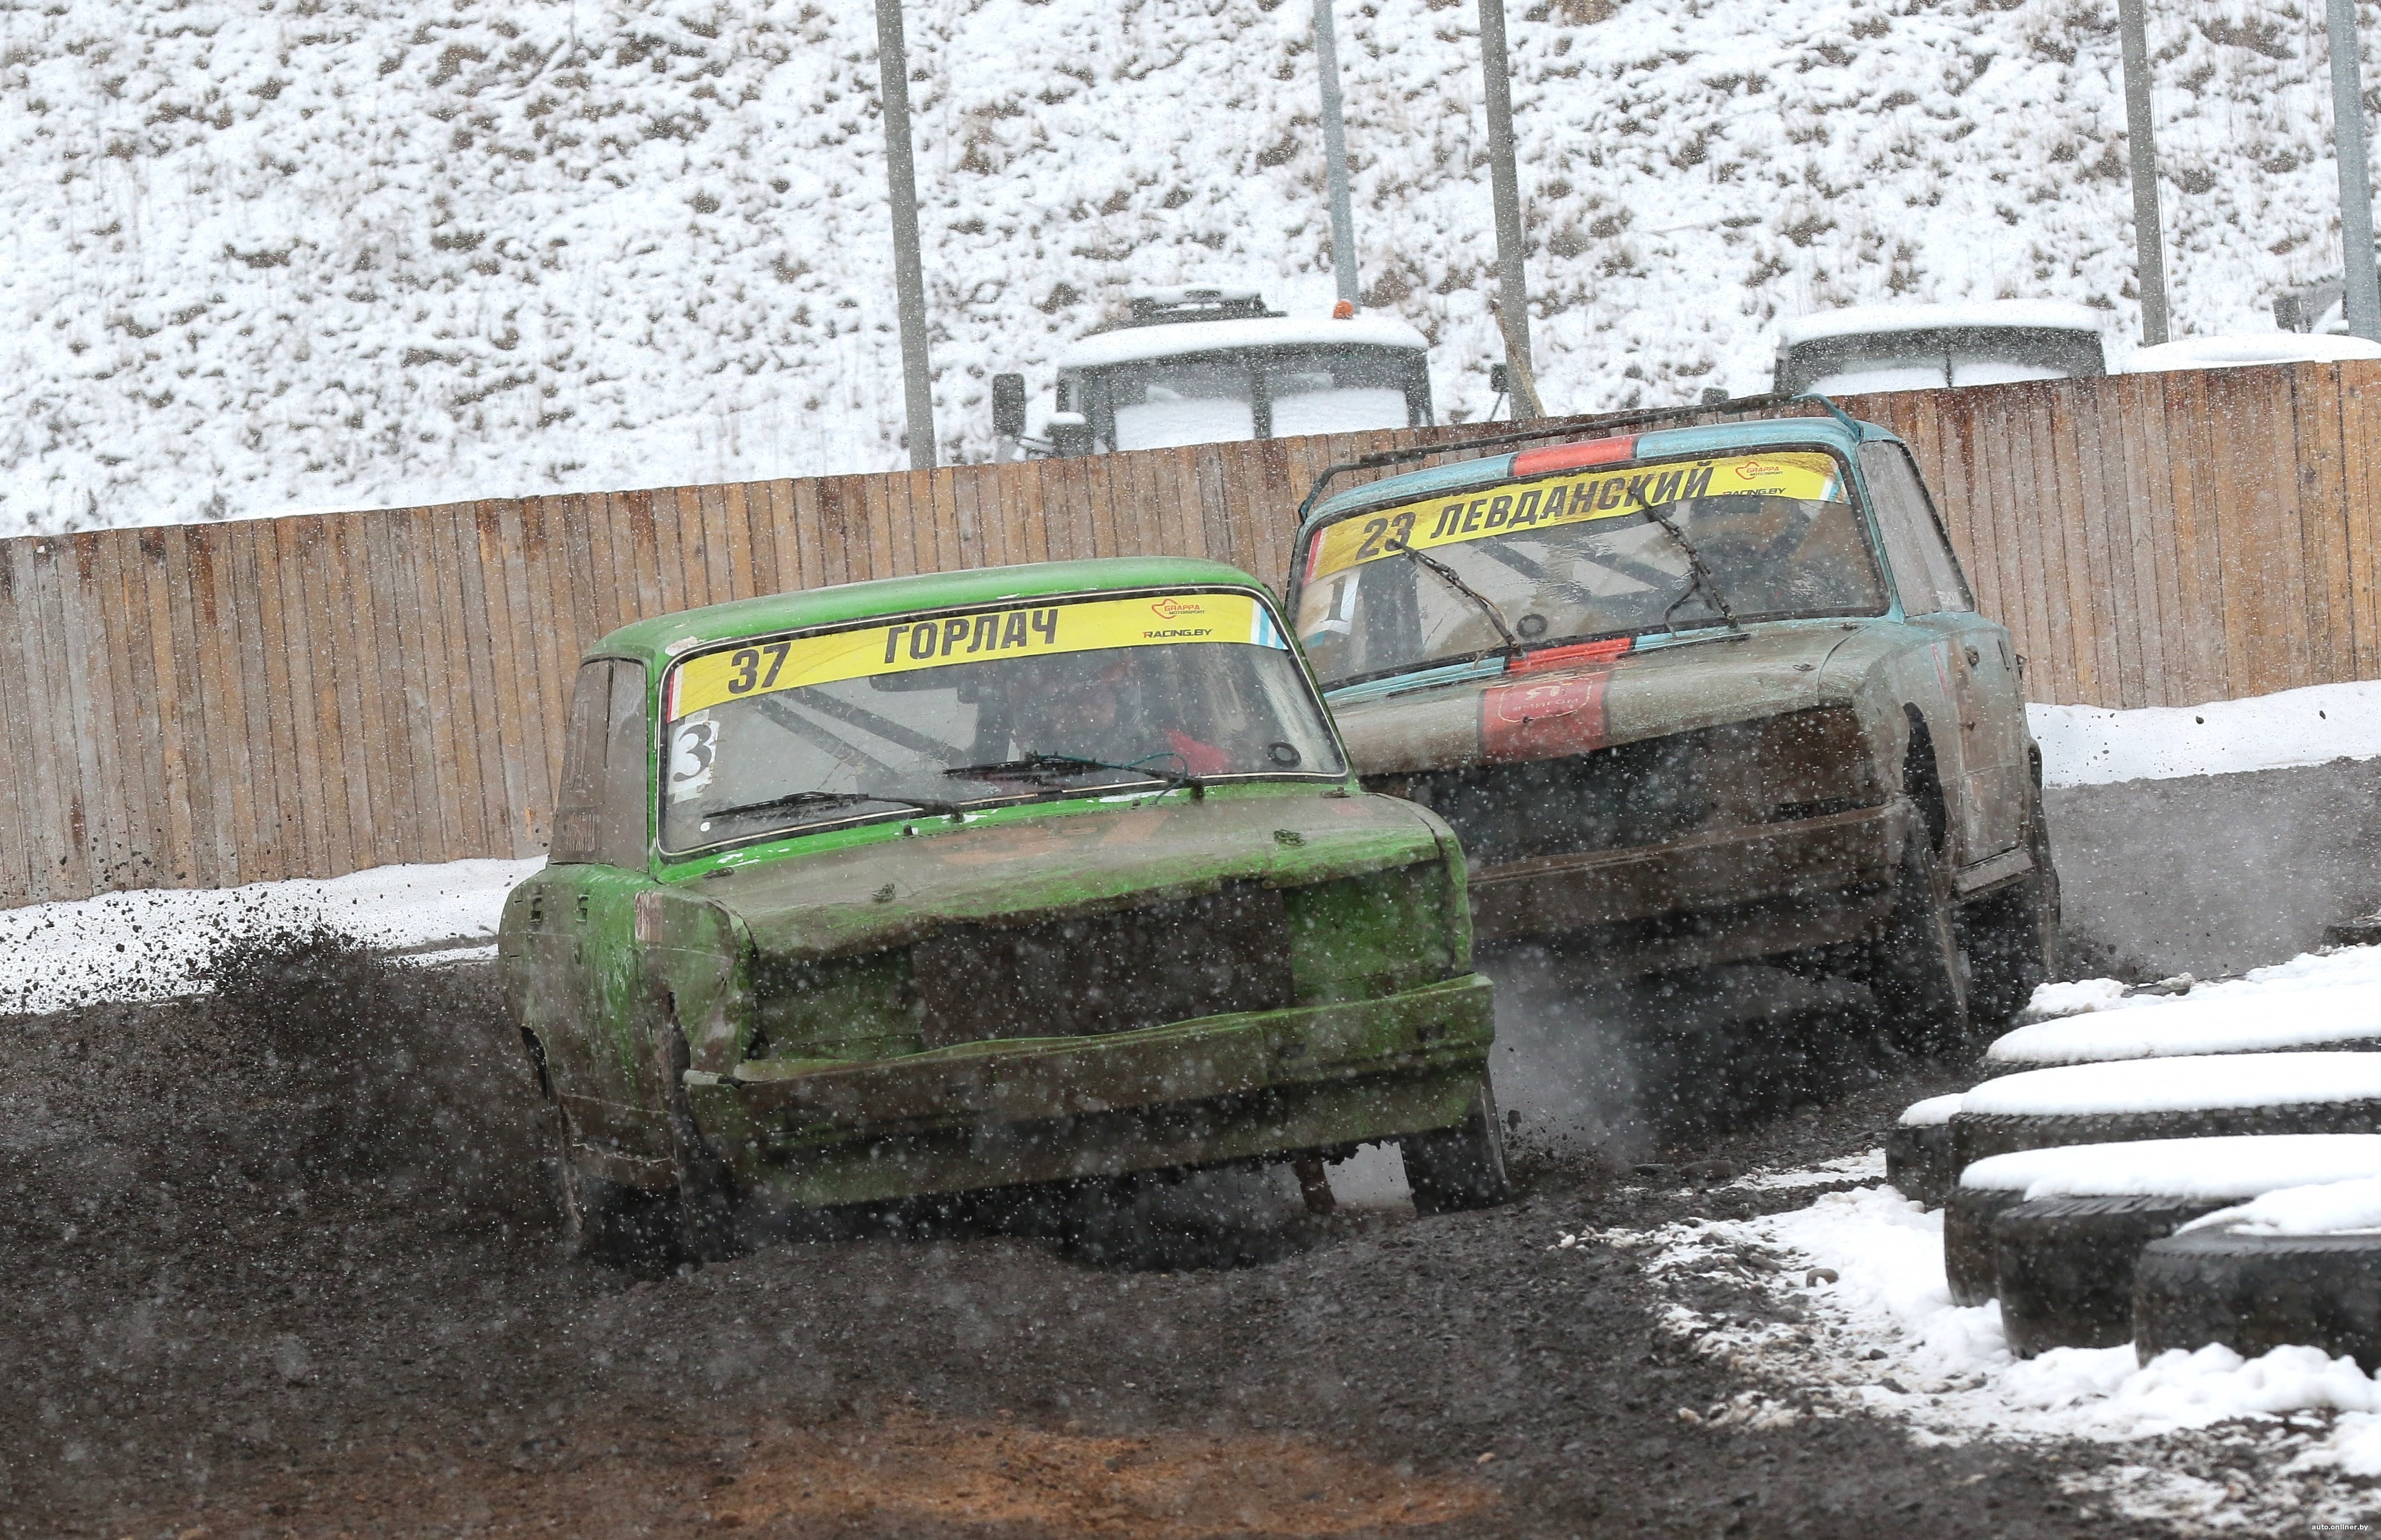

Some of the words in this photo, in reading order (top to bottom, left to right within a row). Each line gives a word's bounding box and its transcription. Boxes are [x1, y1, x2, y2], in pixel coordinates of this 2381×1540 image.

[1356, 513, 1416, 559] 23
[1430, 461, 1714, 539] ЛЕВДАНСКИЙ
[728, 642, 791, 694] 37
[884, 609, 1058, 664] ГОРЛАЧ
[1143, 629, 1212, 638] RACING.BY
[674, 725, 712, 782] 3
